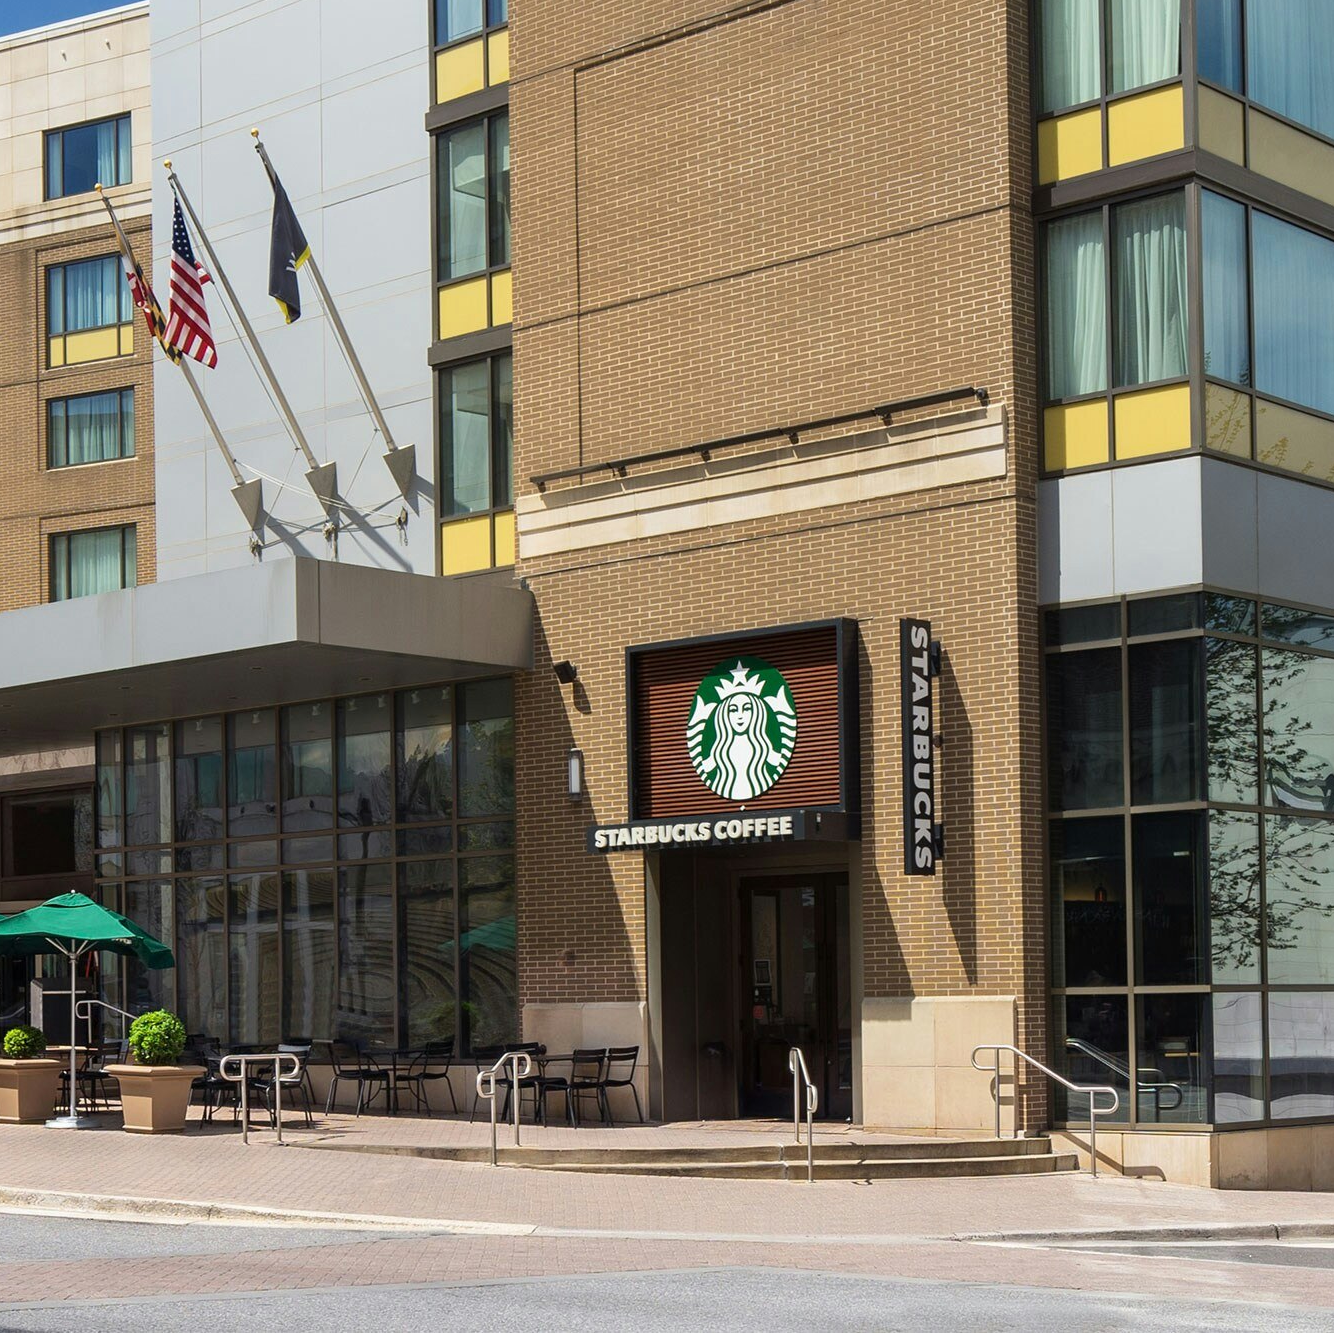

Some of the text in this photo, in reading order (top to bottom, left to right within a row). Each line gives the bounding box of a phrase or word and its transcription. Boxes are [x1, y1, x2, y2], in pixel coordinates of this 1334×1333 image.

[911, 625, 932, 869] STARBUCKS
[594, 816, 793, 850] STARBUCKS COFFEE
